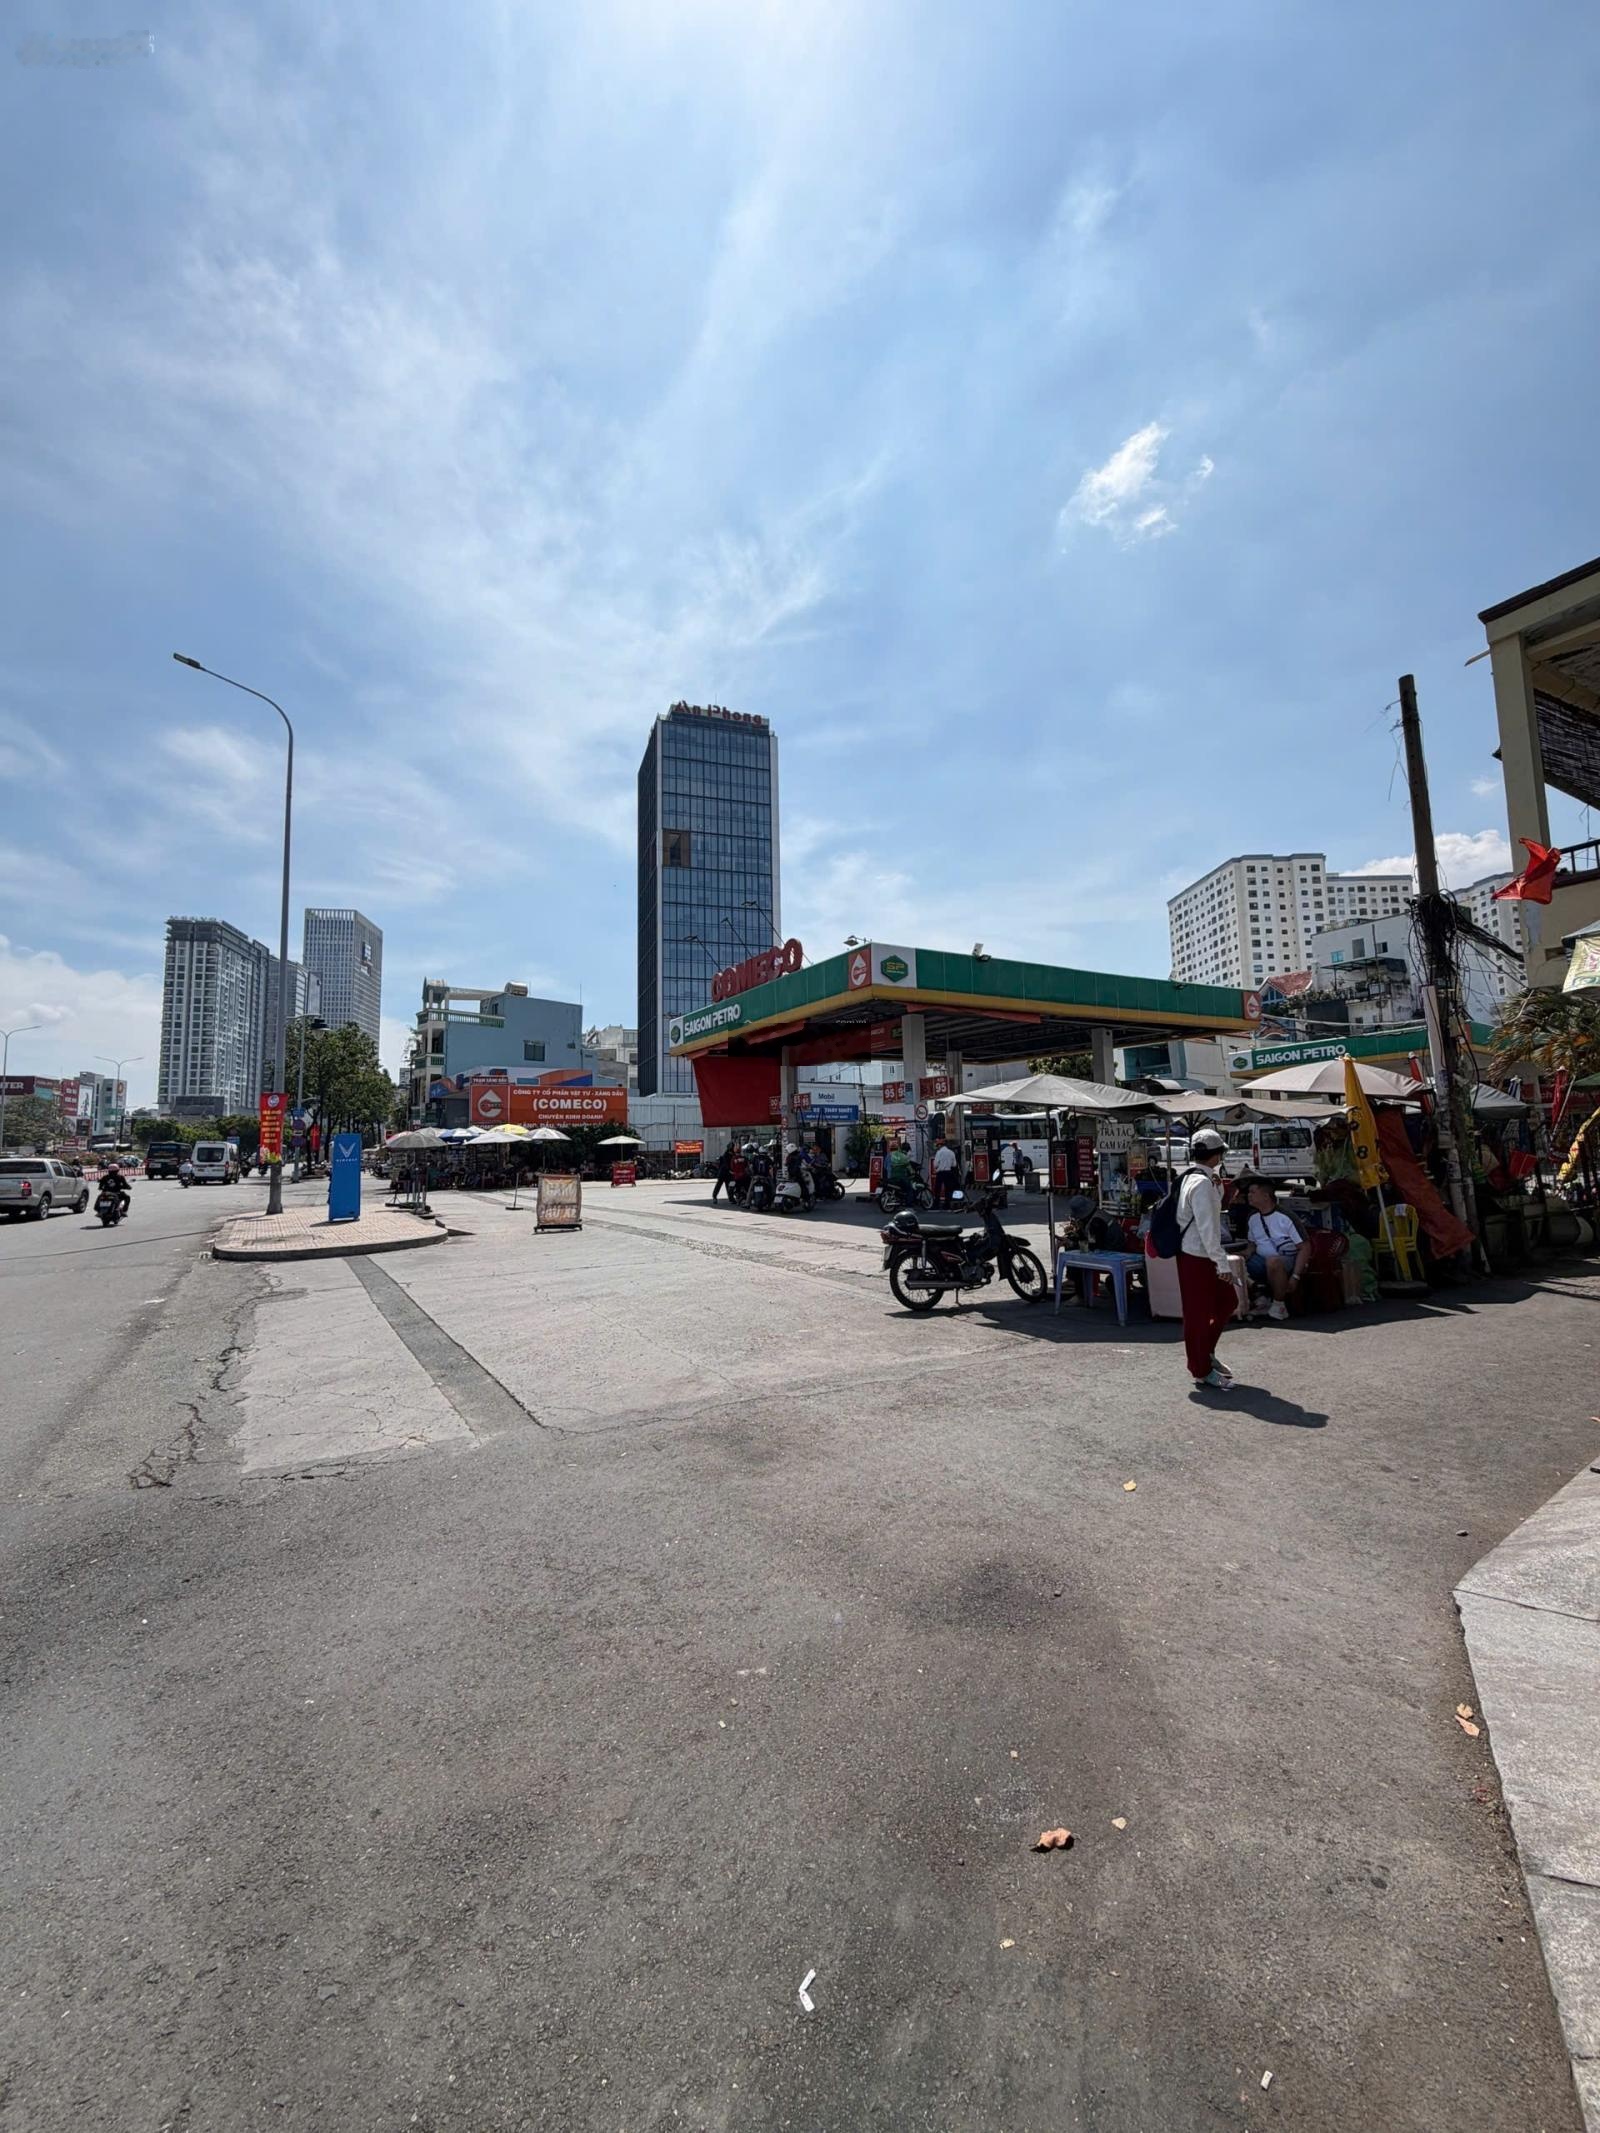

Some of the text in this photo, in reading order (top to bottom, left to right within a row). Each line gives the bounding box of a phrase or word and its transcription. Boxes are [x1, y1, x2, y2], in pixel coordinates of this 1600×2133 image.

[674, 700, 762, 727] An Phong
[711, 938, 803, 1003] COMECO
[684, 1004, 741, 1036] SAIGON PETRO
[1256, 1044, 1346, 1065] SAIGON PETRO
[513, 1088, 531, 1096] CÔNG
[542, 1088, 551, 1096] CỔ
[884, 1089, 895, 1098] 95
[935, 1082, 946, 1093] 95
[818, 1092, 835, 1100] Mobil
[533, 1098, 607, 1111] (COMECO)
